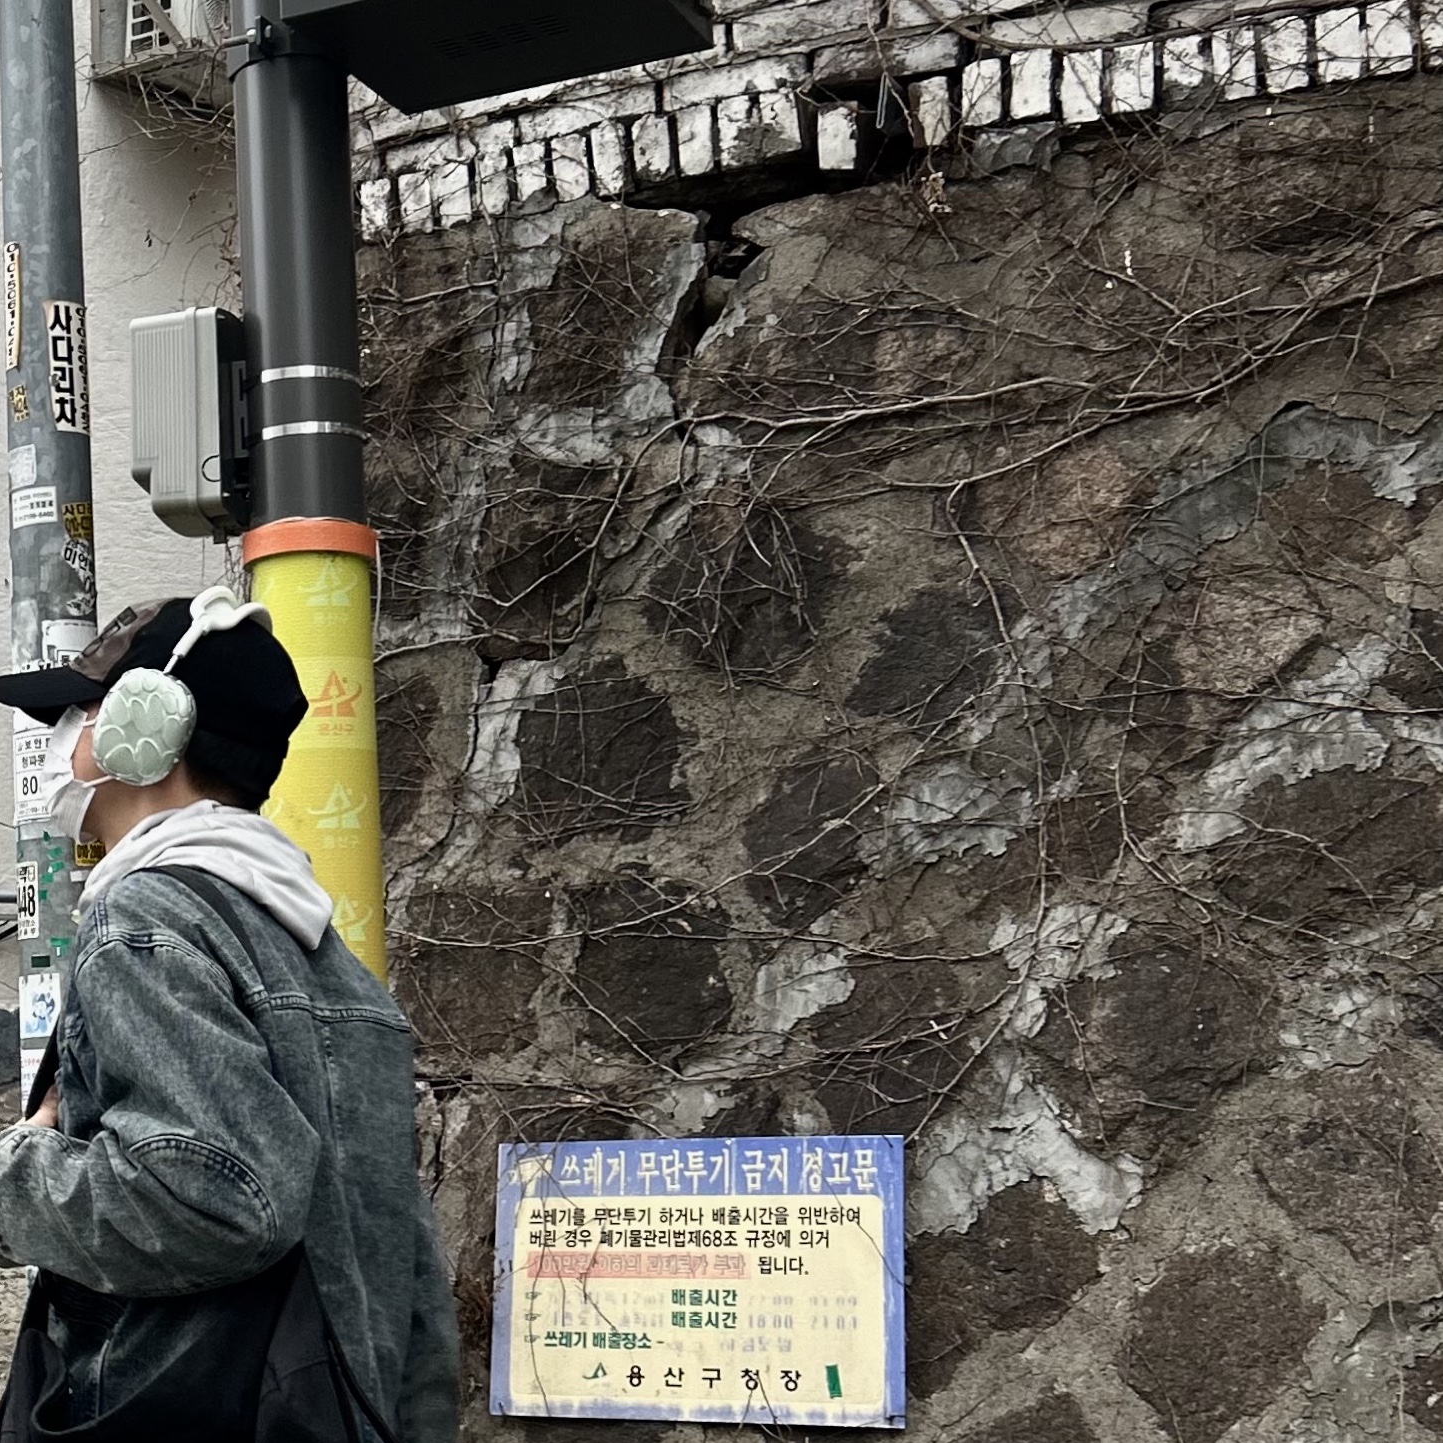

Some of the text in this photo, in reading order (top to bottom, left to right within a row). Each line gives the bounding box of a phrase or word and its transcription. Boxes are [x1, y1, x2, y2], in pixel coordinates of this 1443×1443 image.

[49, 304, 77, 428] 사다리차
[559, 1146, 878, 1196] 쓰레기 무단투기 금지 경고문
[529, 1206, 861, 1227] 쓰레기를 무단투기 하거나 배출시간을 위반하여
[530, 1229, 830, 1248] 버린 경우 폐기물관리법제68조 규정에 의거
[757, 1257, 809, 1276] 됩니다.
[672, 1289, 737, 1307] 배출시간
[672, 1311, 738, 1328] 배출시간
[544, 1332, 587, 1349] 쓰레기
[593, 1332, 652, 1349] 배출장소
